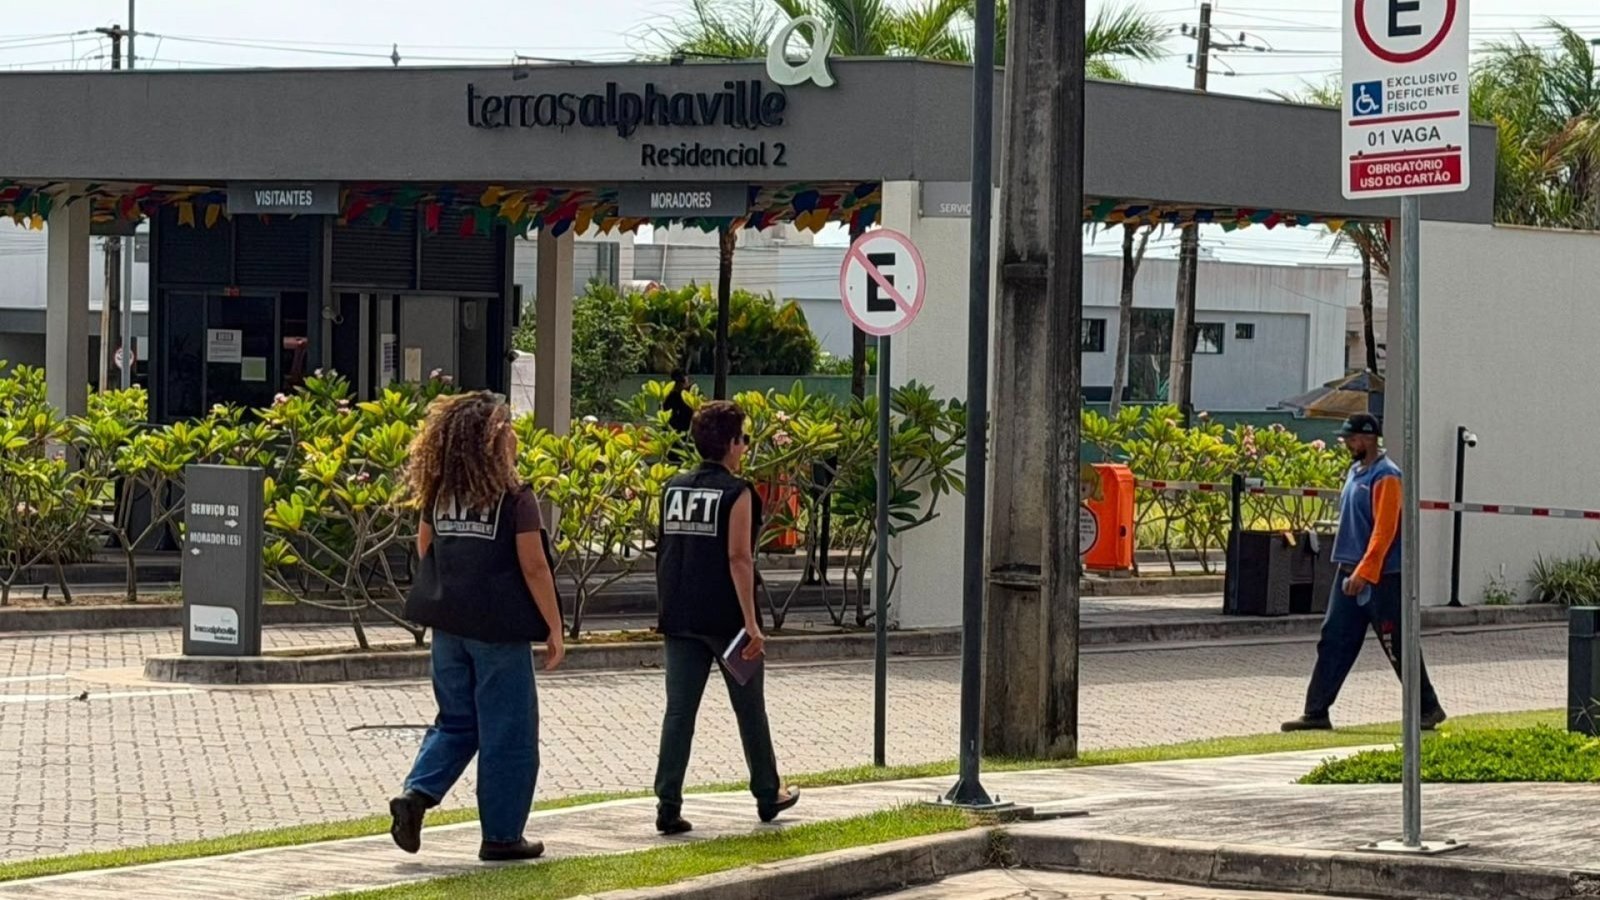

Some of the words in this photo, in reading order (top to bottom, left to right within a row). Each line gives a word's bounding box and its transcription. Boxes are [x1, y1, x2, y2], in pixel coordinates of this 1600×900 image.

[1388, 0, 1421, 37] E
[1386, 71, 1457, 88] EXCLUSIVO
[1386, 84, 1460, 100] DEFICIENTE
[467, 80, 787, 137] terrasalphaville
[1387, 100, 1428, 113] FÍSICO
[1368, 130, 1385, 146] 01
[1391, 126, 1441, 144] VAGA
[641, 142, 767, 167] Residencial
[772, 143, 787, 166] 2
[1366, 158, 1443, 175] OBRIGATÓRIO
[1360, 177, 1383, 188] USO
[1385, 174, 1402, 186] DO
[1404, 170, 1451, 184] CARTÃO
[254, 190, 313, 206] VISITANTES
[650, 192, 712, 208] MORADORES
[866, 253, 896, 312] E
[191, 503, 225, 517] SERVIÇO
[667, 490, 719, 522] AFT
[190, 532, 226, 545] MORADOR
